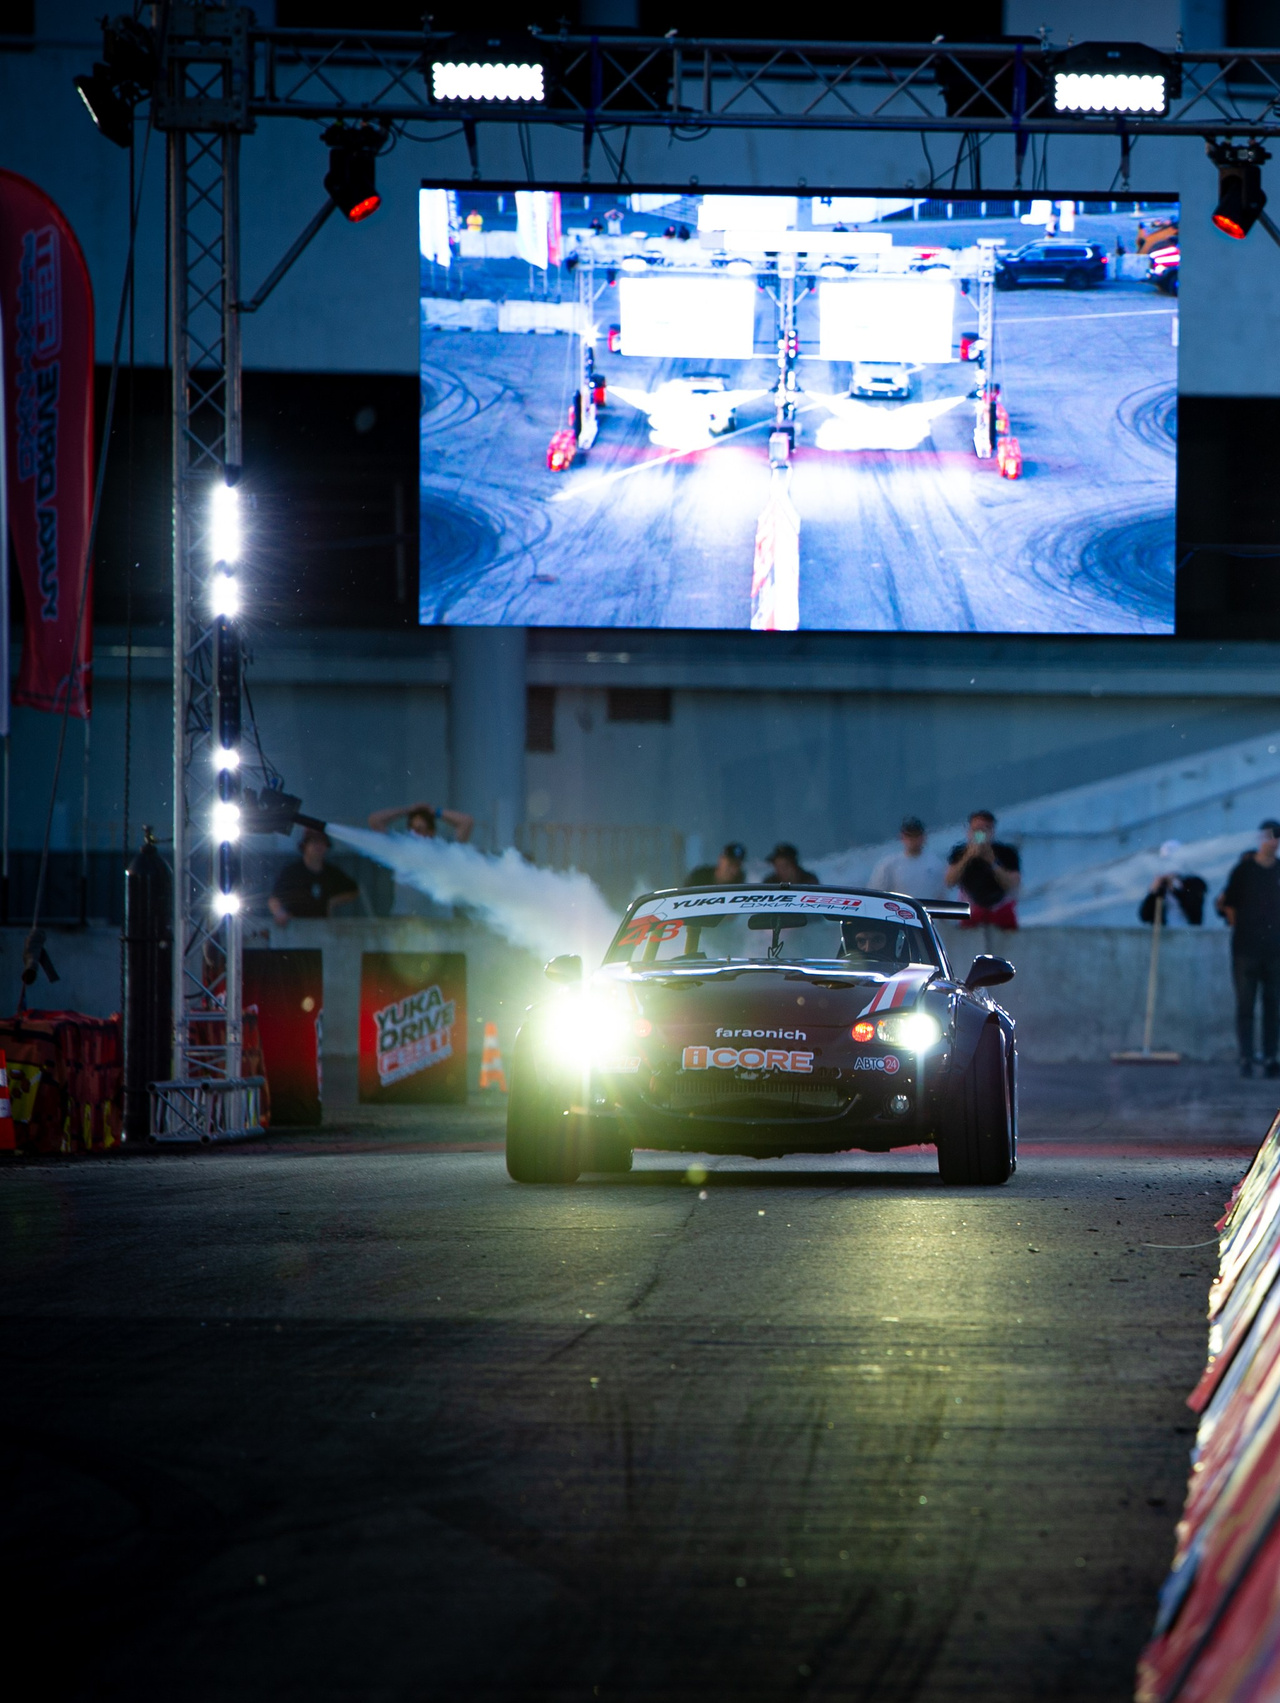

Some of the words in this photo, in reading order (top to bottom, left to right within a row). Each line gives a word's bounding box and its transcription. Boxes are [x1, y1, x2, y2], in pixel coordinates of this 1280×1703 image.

[673, 896, 726, 910] YUKA
[728, 894, 797, 904] DRIVE
[803, 895, 862, 906] FEST
[377, 989, 442, 1030] YUKA
[380, 1003, 454, 1052] DRIVE
[715, 1027, 807, 1041] faraonich
